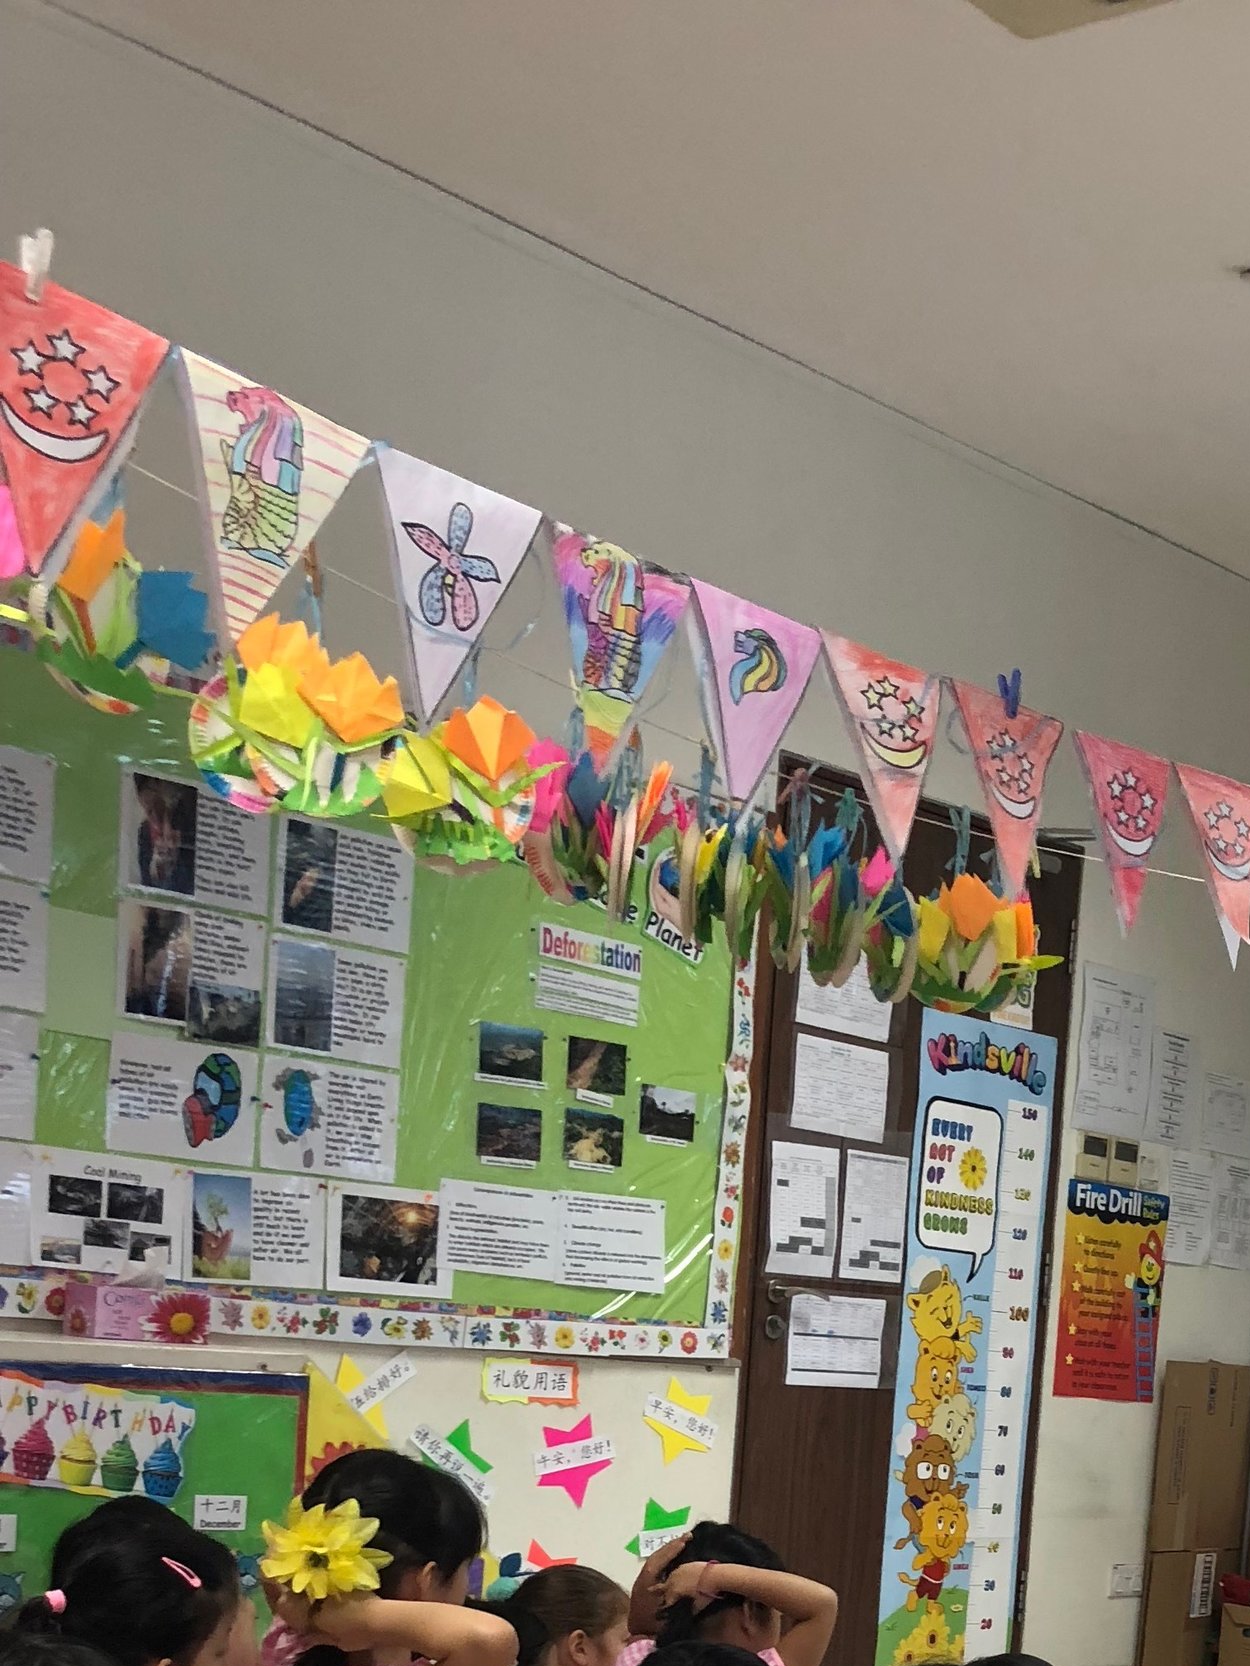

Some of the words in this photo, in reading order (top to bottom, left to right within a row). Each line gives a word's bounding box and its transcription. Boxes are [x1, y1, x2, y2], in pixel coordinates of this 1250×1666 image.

[644, 911, 703, 960] Planet
[542, 926, 641, 972] Deforestation
[927, 1032, 1047, 1096] Kindsville
[1022, 1108, 1037, 1120] 150
[932, 1118, 974, 1142] EVERY
[929, 1142, 956, 1162] ACT
[1018, 1148, 1034, 1161] 140
[84, 1165, 105, 1177] Coal
[108, 1168, 142, 1183] Mining
[927, 1166, 946, 1184] OF
[924, 1189, 993, 1215] KINDNESS
[1076, 1184, 1107, 1211] Fire
[1108, 1188, 1142, 1217] Drill
[923, 1212, 968, 1235] GROWS
[1012, 1228, 1028, 1240] 120
[1008, 1268, 1024, 1280] 110
[1009, 1306, 1029, 1321] 100
[492, 1369, 568, 1392] 礼貌用语
[0, 1394, 58, 1420] PPY
[61, 1401, 192, 1440] BIRTHDAY
[998, 1426, 1008, 1437] 70
[200, 1498, 242, 1515] 十二月
[992, 1503, 1002, 1514] 50
[200, 1520, 242, 1529] December
[645, 1535, 679, 1550] 对不
[984, 1580, 996, 1591] 30
[980, 1618, 992, 1630] 20
